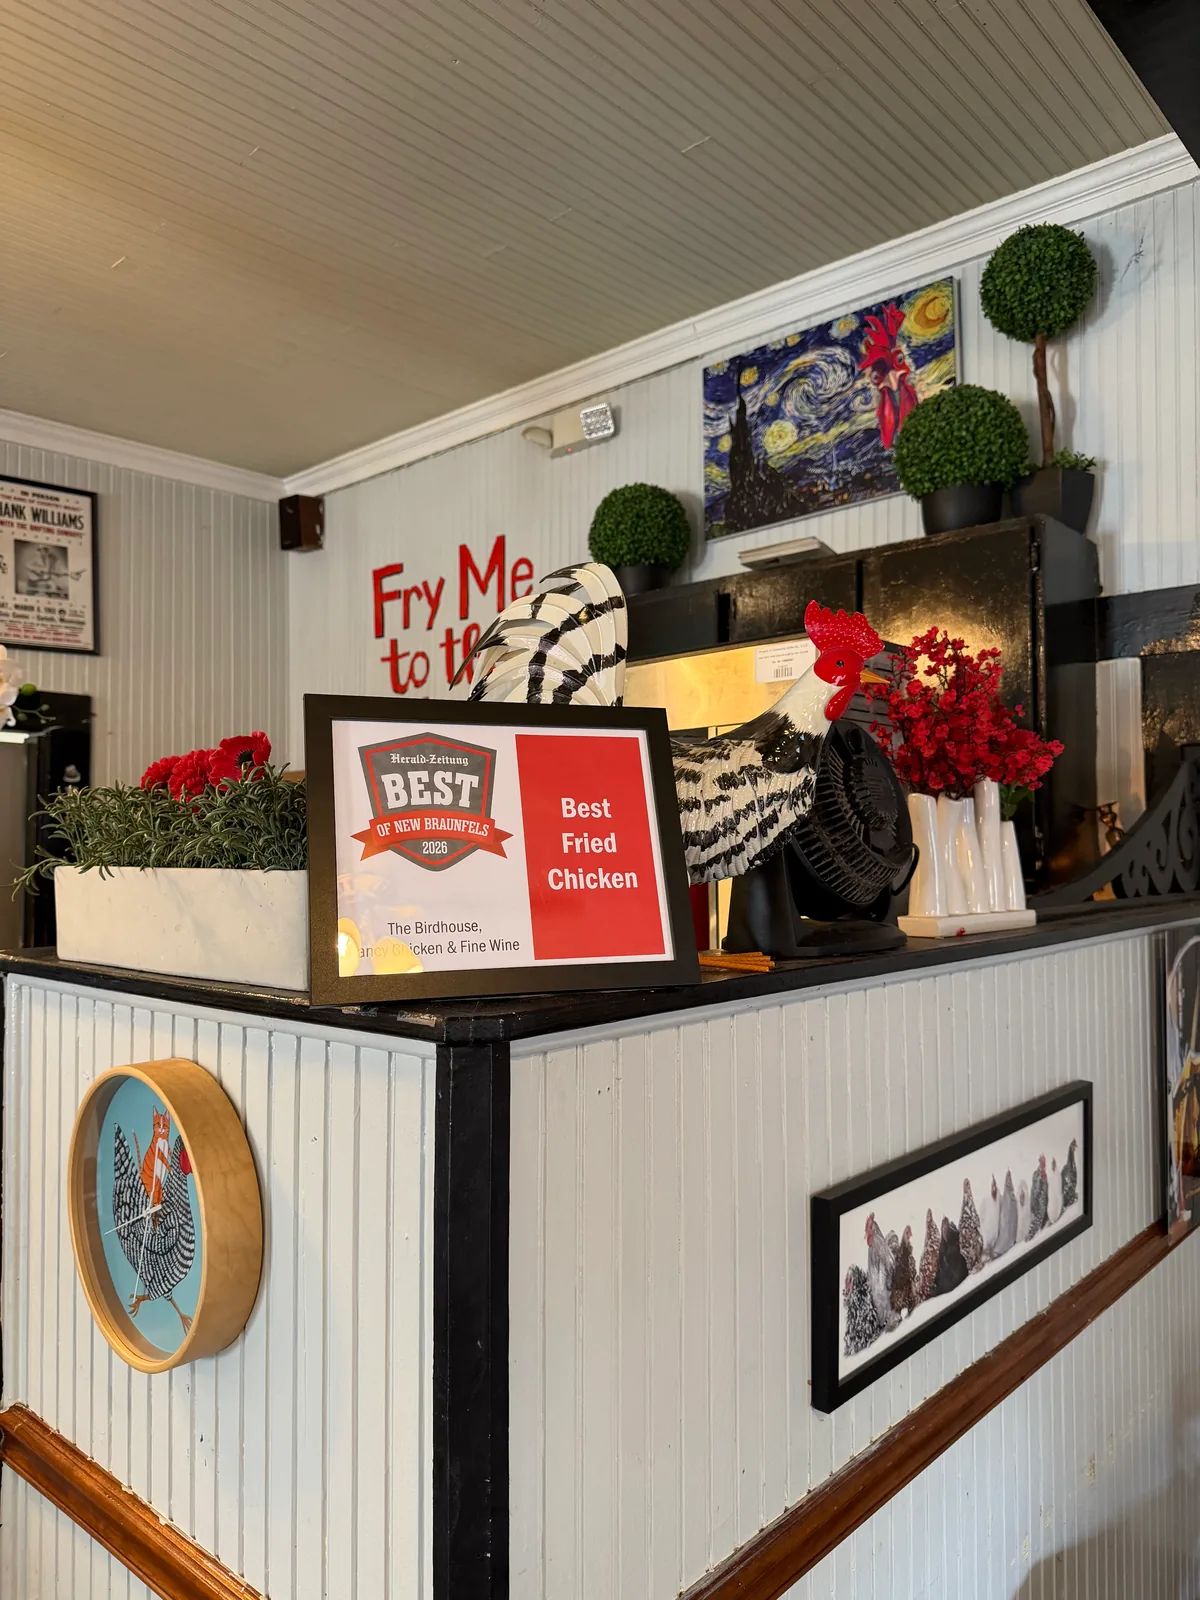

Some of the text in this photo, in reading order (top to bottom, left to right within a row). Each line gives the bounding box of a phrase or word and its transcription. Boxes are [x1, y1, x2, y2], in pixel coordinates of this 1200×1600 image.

[31, 506, 85, 531] WILLIAMS
[372, 534, 534, 639] Fry Me
[380, 638, 430, 695] to
[390, 753, 469, 766] Herald-Zeitung
[381, 770, 480, 809] BEST
[561, 797, 612, 819] Best
[376, 817, 489, 837] OF NEW BRAUNFELS
[422, 841, 448, 854] 2026
[561, 832, 617, 853] Fried
[547, 867, 638, 890] Chicken
[387, 921, 482, 936] The Birdhouse,
[358, 944, 388, 960] ancy
[447, 940, 457, 954] &
[460, 938, 486, 953] Fine
[489, 938, 520, 952] Wine
